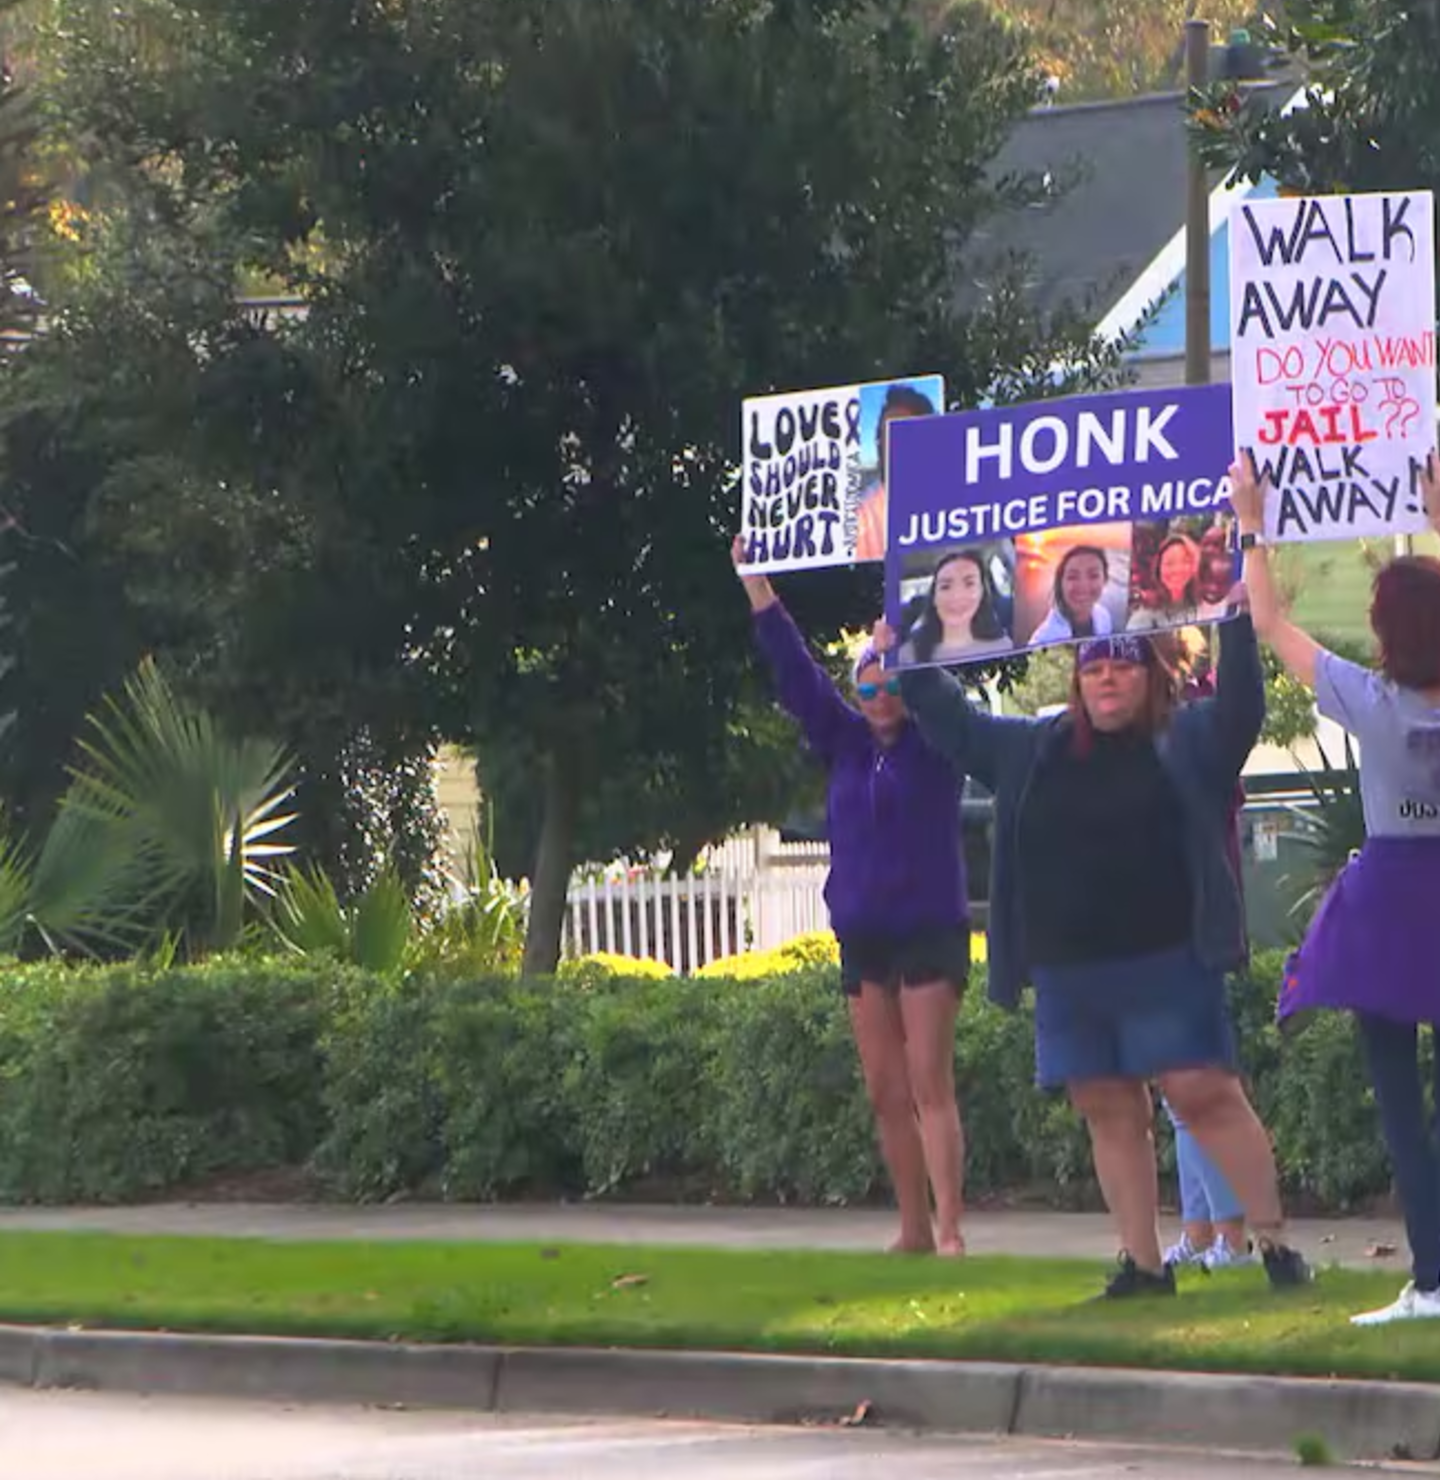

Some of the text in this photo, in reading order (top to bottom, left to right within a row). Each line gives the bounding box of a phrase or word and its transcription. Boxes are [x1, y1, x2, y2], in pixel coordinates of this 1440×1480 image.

[1241, 196, 1416, 266] WALK
[1236, 268, 1387, 339] AWAY
[1256, 330, 1435, 385] DO YOU WANT
[1286, 376, 1406, 406] TO GO TO
[750, 400, 842, 461] LOVE
[965, 404, 1180, 485] HONK
[749, 441, 841, 498] SHOULD
[1245, 444, 1371, 491] WALK
[747, 472, 840, 529] NEVER
[898, 475, 1234, 545] JUSTICE FOR MICA
[742, 510, 841, 565] HURT
